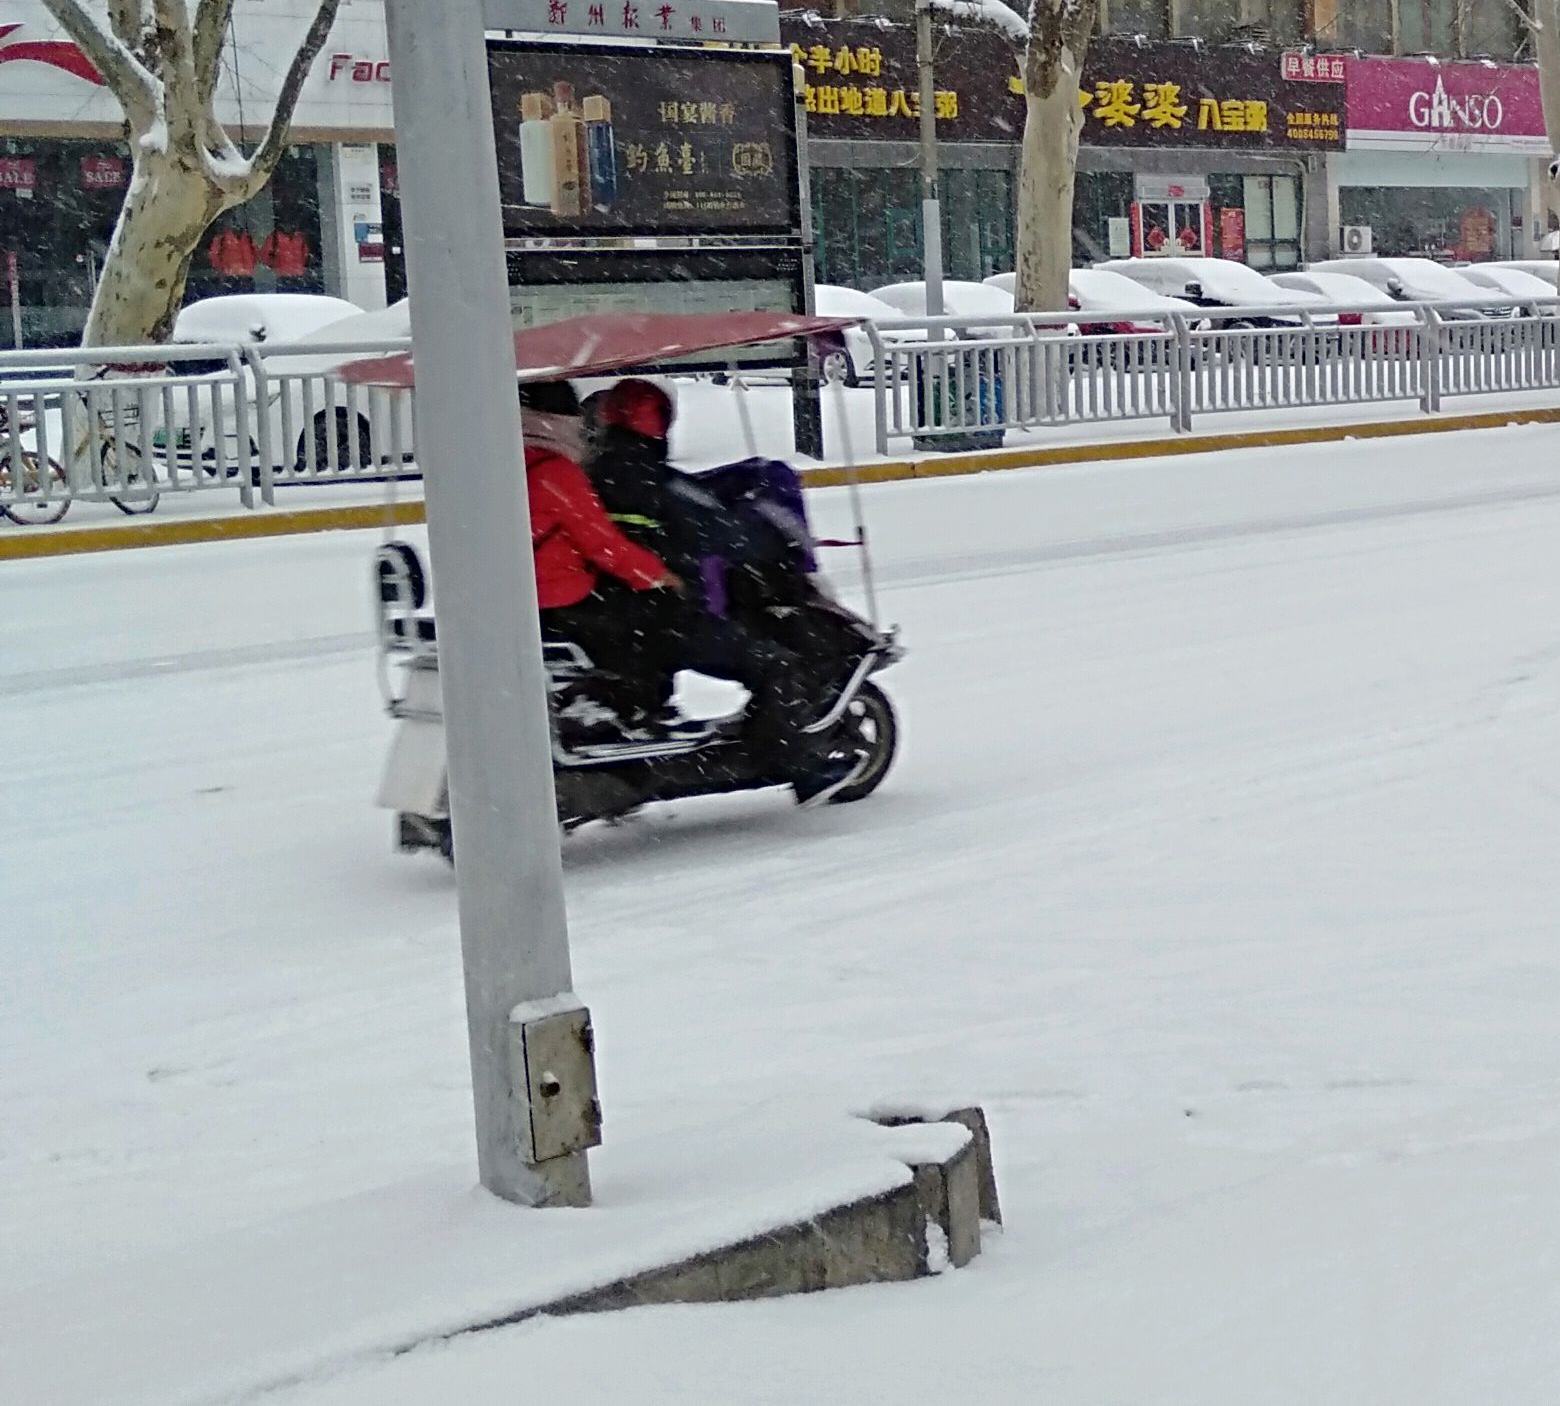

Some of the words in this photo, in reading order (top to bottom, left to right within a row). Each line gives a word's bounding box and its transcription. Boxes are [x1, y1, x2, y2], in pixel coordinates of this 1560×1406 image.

[1286, 56, 1345, 79] 早餐供应
[1079, 78, 1188, 129] 婆婆
[1198, 97, 1268, 133] 八宝粥
[1409, 73, 1503, 130] GANSO
